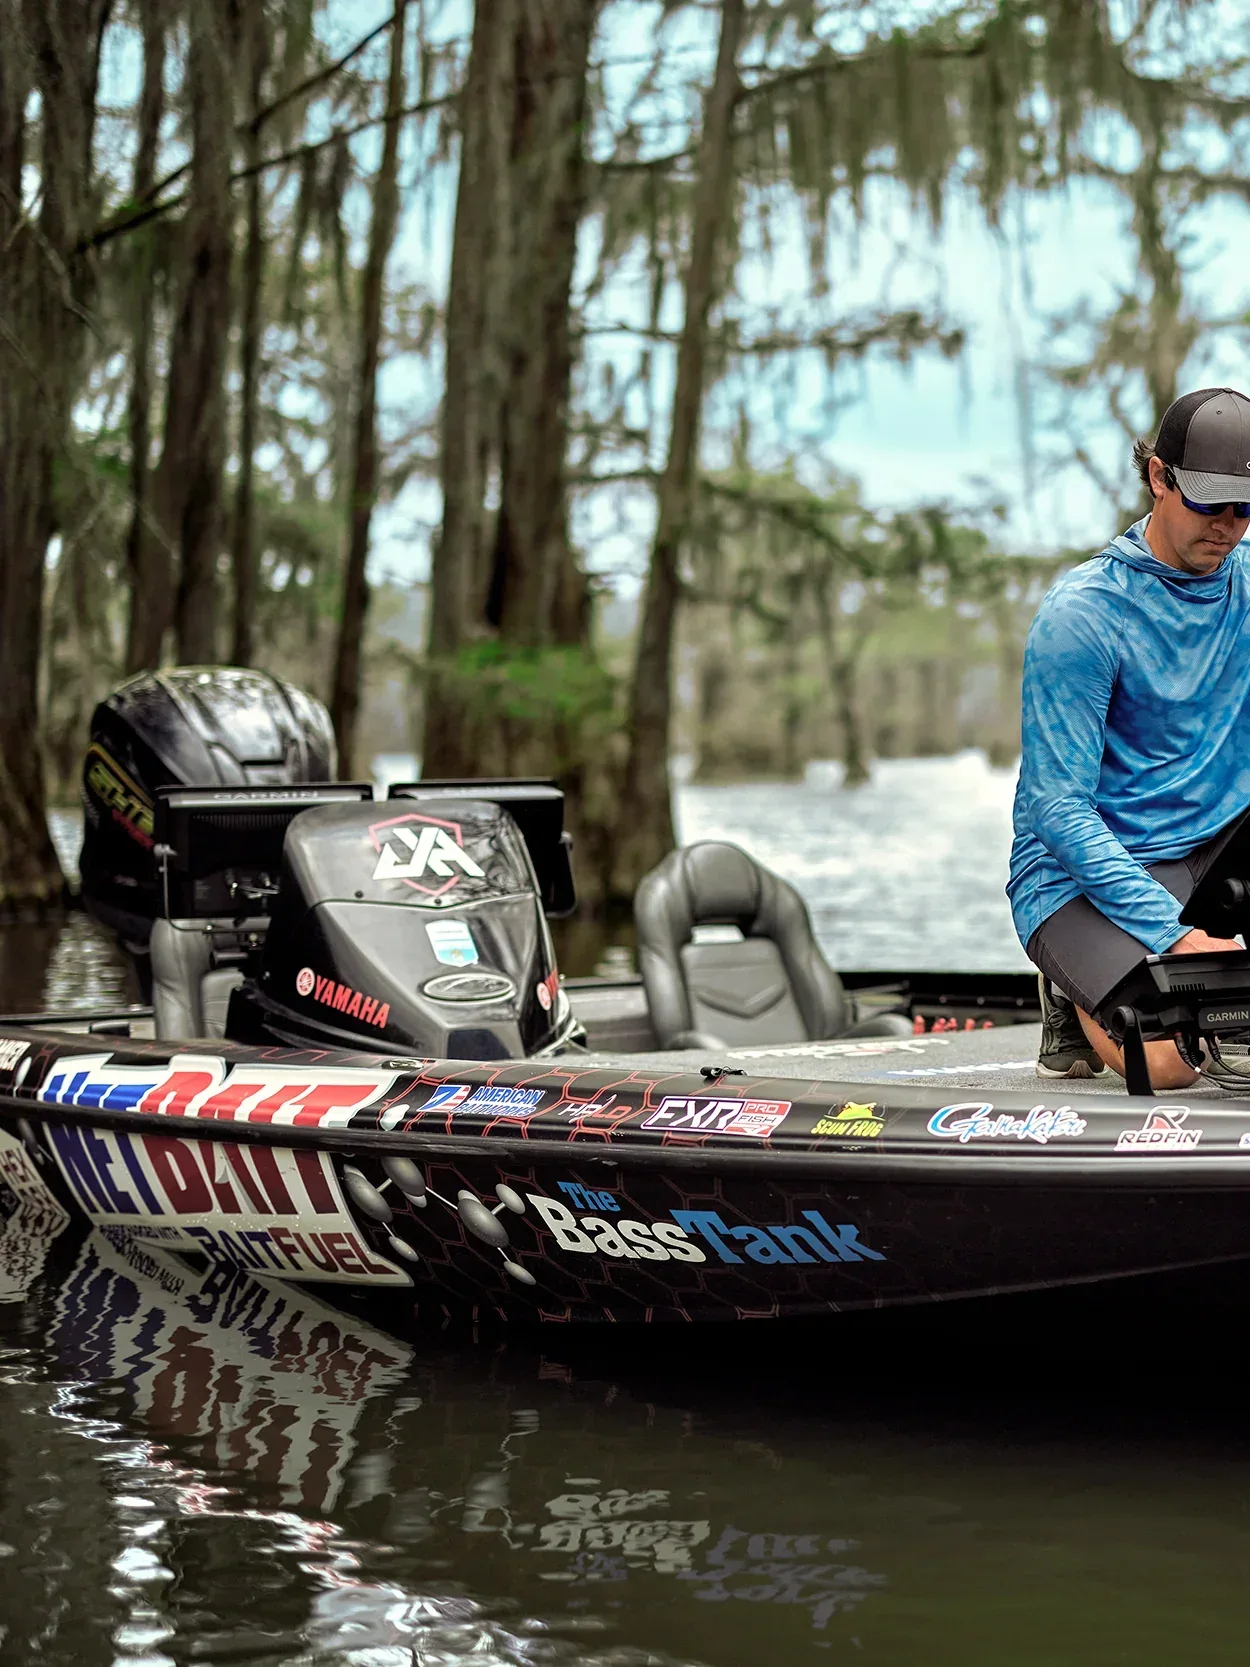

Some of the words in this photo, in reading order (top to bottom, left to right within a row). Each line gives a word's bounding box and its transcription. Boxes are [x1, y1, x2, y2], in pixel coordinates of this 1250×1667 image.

[214, 790, 319, 800] GARMIN
[313, 975, 391, 1029] YAMAHA
[1206, 1011, 1250, 1023] GARMIN
[468, 1086, 546, 1106] AMERICAN
[647, 1099, 744, 1131] FXR
[744, 1102, 779, 1115] PRO
[737, 1114, 777, 1124] FISH
[811, 1118, 847, 1136] SCUM
[847, 1120, 885, 1138] FROG
[1119, 1131, 1201, 1144] REDFIN
[556, 1180, 622, 1213] The
[180, 1225, 400, 1275] BAITFUEL
